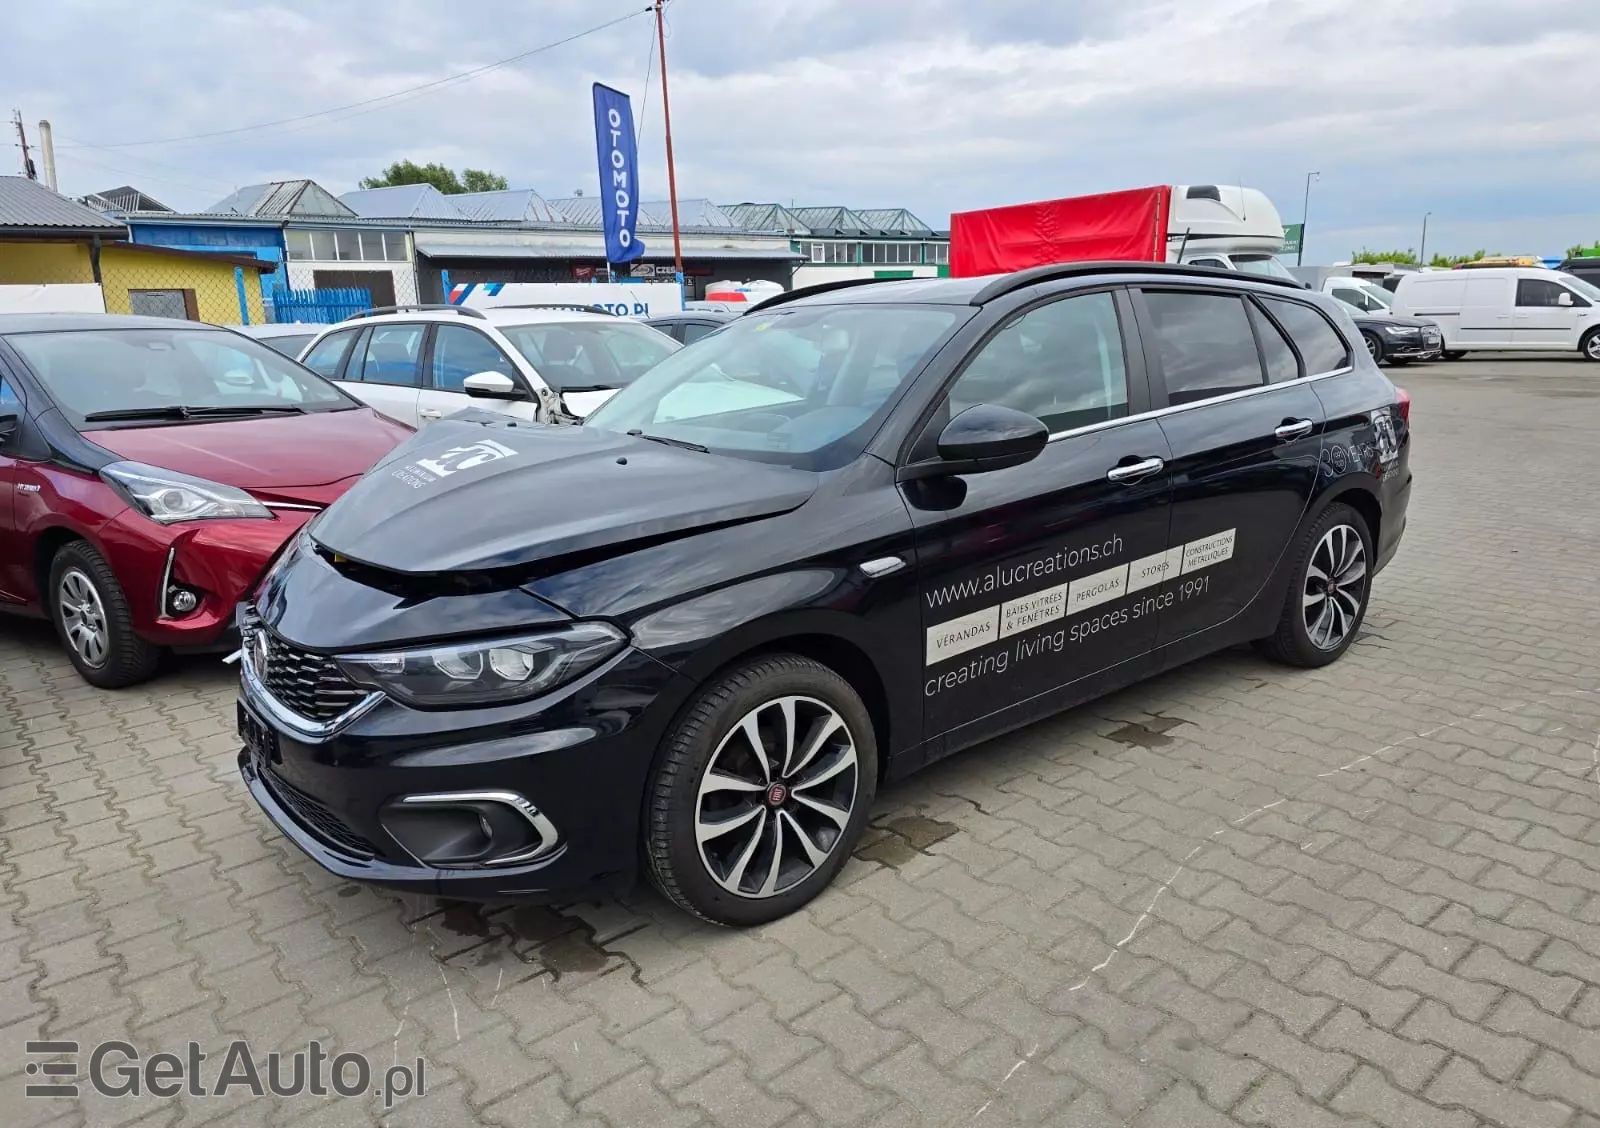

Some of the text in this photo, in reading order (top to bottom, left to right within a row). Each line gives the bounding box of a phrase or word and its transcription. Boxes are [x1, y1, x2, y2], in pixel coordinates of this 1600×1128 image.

[607, 108, 631, 248] OTOMOTO
[1185, 535, 1233, 557] CONSTRUCTIONS
[925, 533, 1123, 609] www.alucreations.ch
[1141, 561, 1170, 578] STORES
[1075, 578, 1120, 603] PERGOLAS
[1006, 602, 1029, 618] BAIES
[924, 575, 1210, 697] creating living spaces since 1991
[936, 621, 991, 649] VÉRANDAS
[1006, 621, 1014, 631] &
